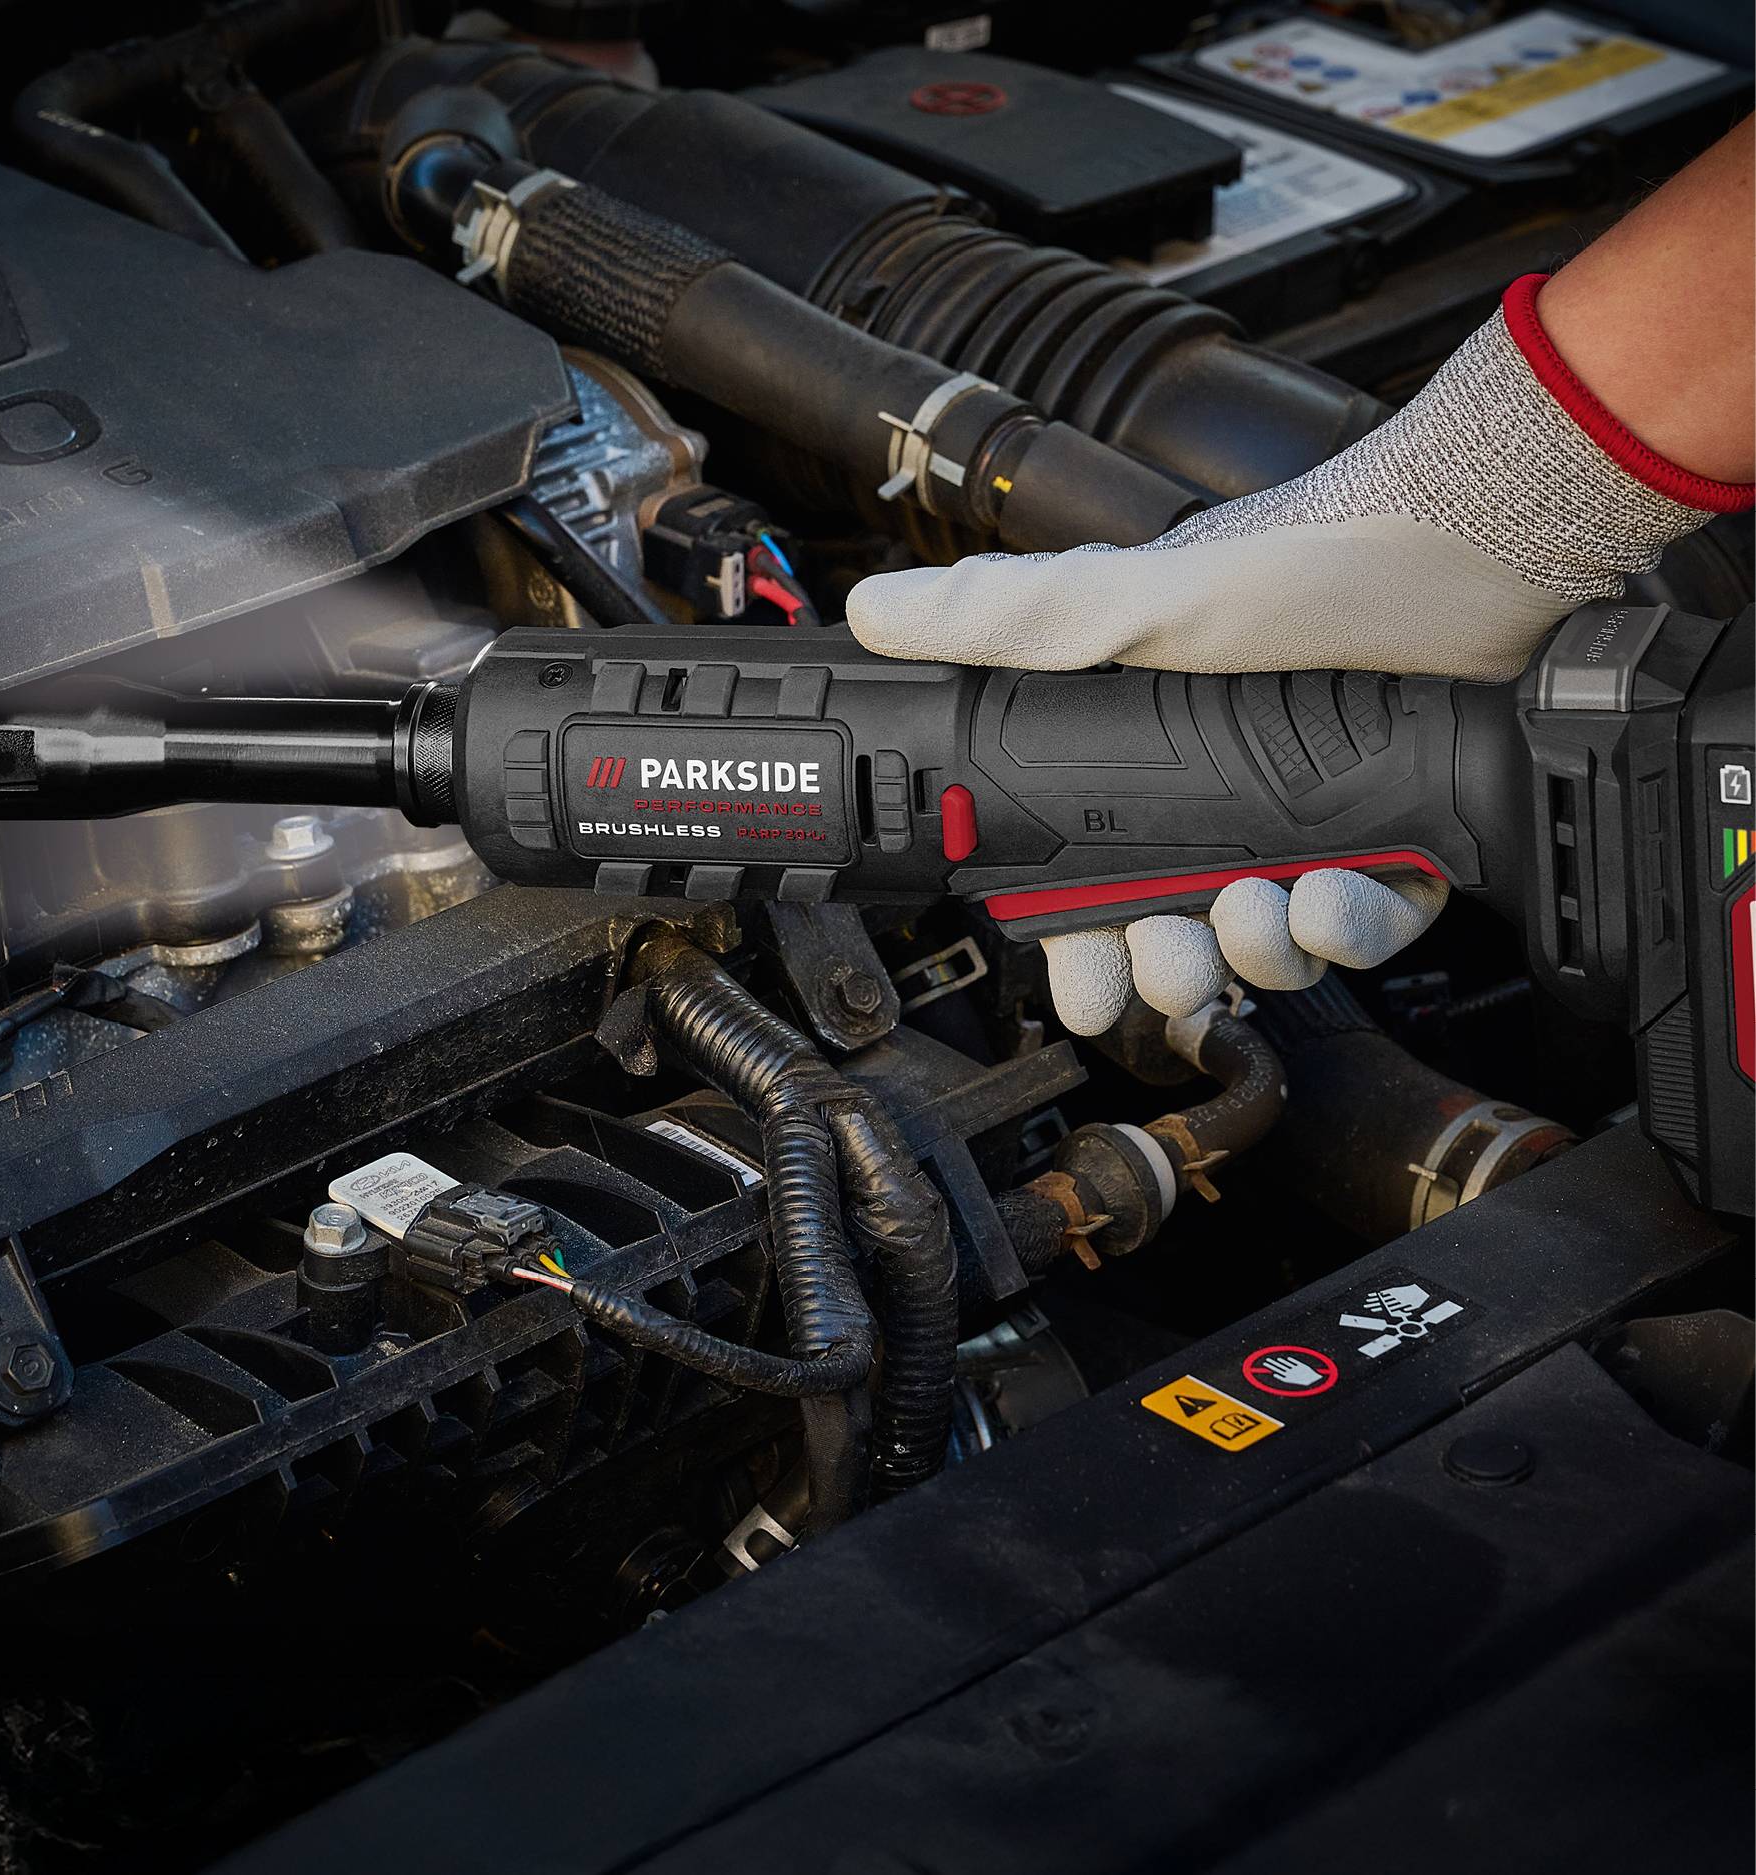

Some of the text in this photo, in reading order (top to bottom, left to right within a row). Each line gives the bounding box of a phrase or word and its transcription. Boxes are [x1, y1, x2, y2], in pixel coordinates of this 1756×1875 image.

[640, 758, 821, 794] PARKSIDE
[633, 799, 823, 817] PERFORMANCE
[578, 822, 722, 838] BRUSHLESS
[1084, 809, 1129, 834] BL
